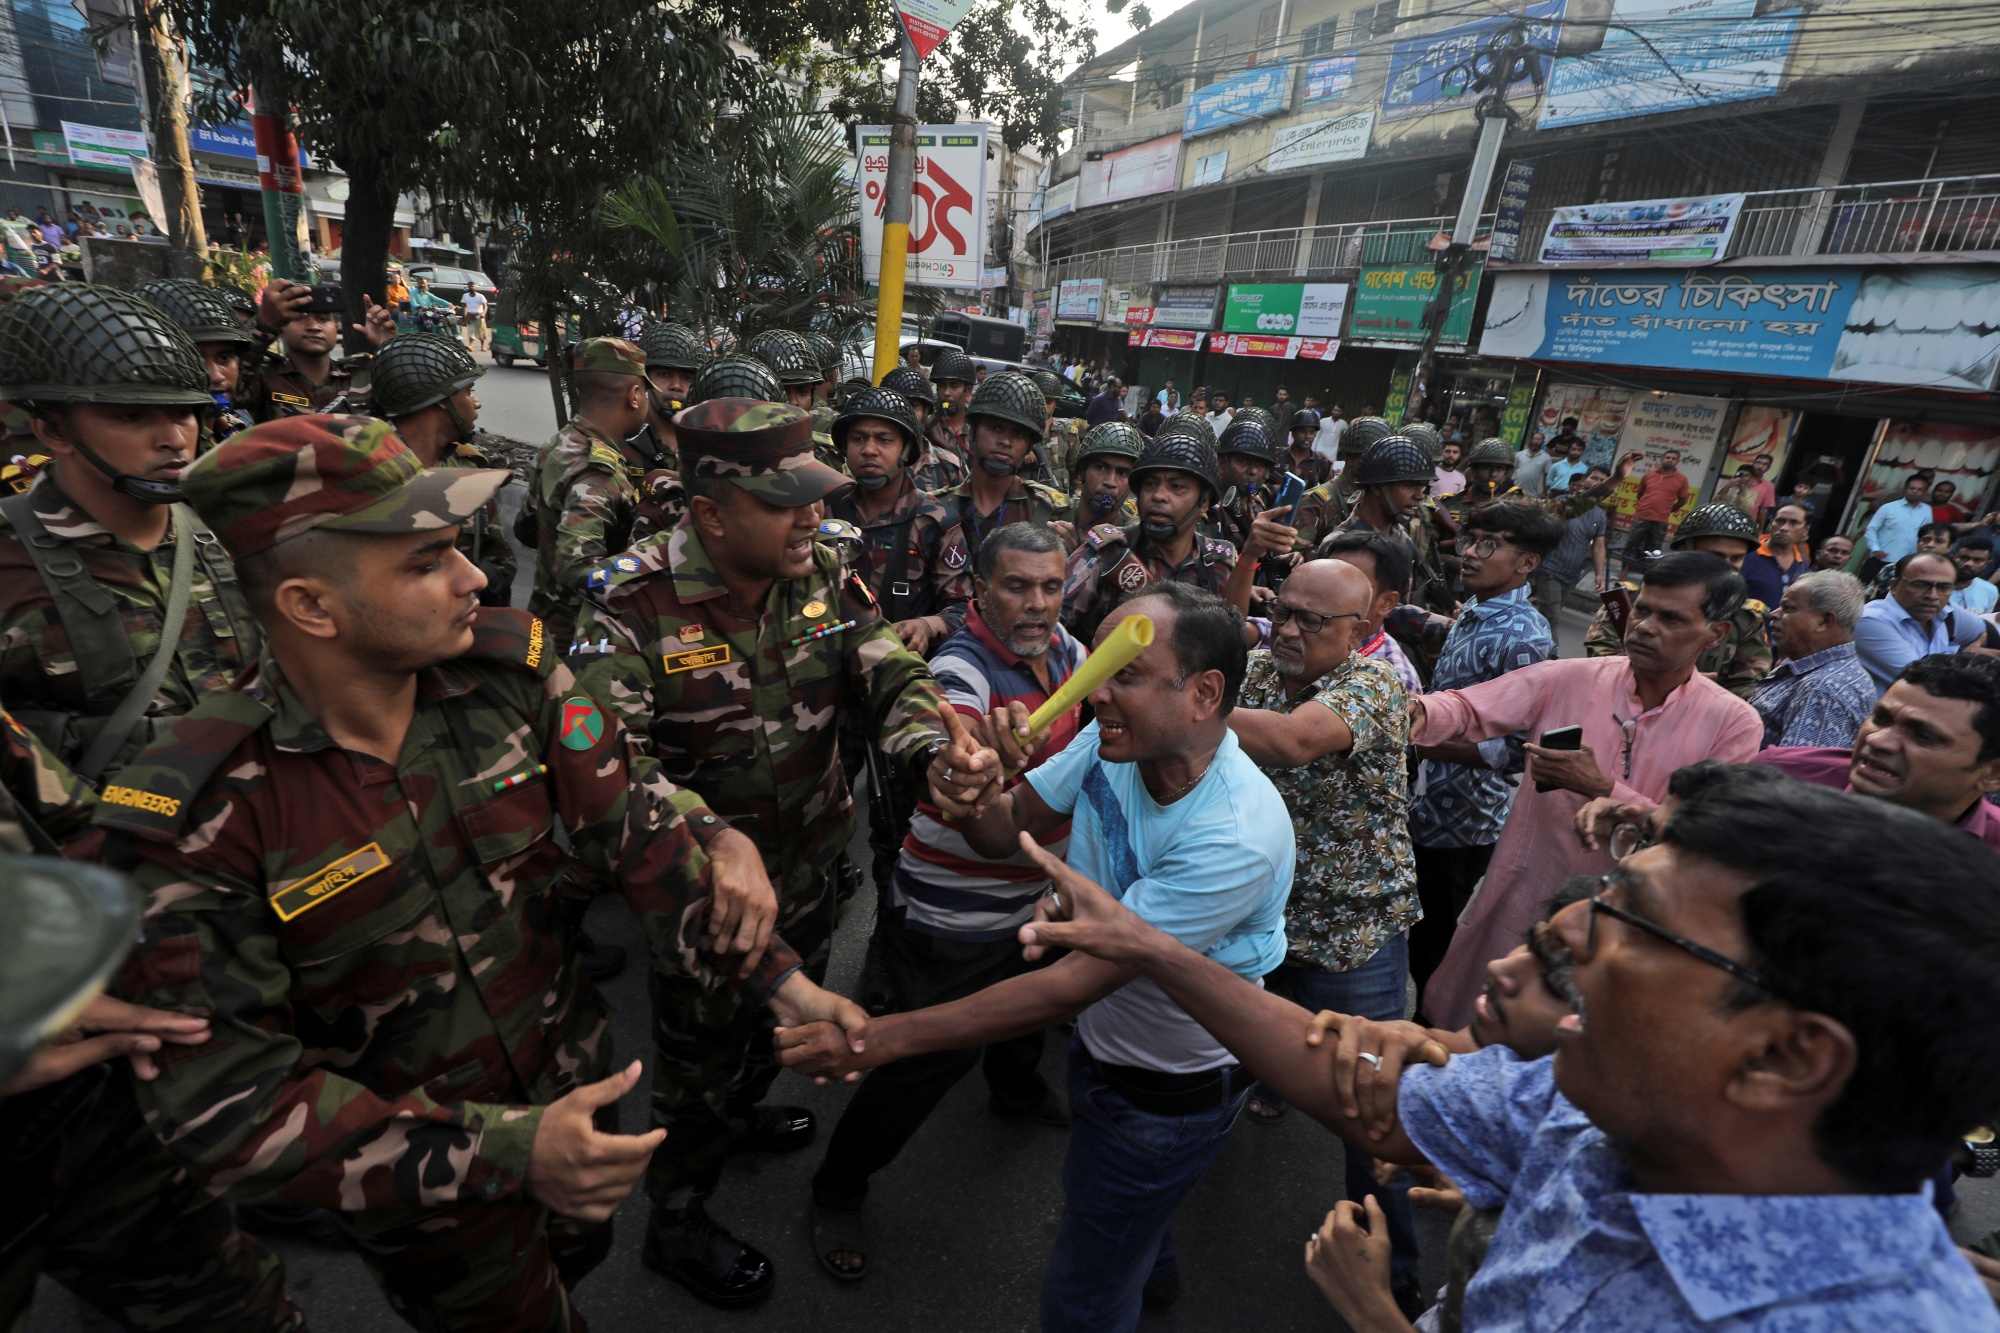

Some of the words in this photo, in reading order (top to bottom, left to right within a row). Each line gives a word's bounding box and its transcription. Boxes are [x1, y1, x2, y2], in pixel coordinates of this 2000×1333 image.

[1550, 77, 1615, 96] NURJAHAN
[1693, 61, 1703, 71] &
[1707, 47, 1783, 69] SURGICAL
[213, 131, 240, 146] Bank
[1300, 135, 1361, 153] Enterprise
[1555, 231, 1603, 239] NURJAHAN
[1605, 229, 1658, 238] SCIENTIFIC
[1670, 226, 1722, 236] SURGICAL
[1364, 269, 1409, 290] গণেশ
[1359, 293, 1381, 301] Musical
[1418, 294, 1434, 303] Shop
[1564, 275, 1671, 309] দাঁতের
[1680, 274, 1841, 314] চিকিৎসা
[1559, 311, 1621, 329] দাঁত
[1628, 313, 1754, 334] বাঁধানো
[1762, 319, 1826, 337] হয়
[1642, 401, 1673, 418] মামুন
[1675, 403, 1719, 422] ডেন্টাল
[525, 617, 544, 668] ENGINEERS
[678, 652, 717, 666] আজাদ
[100, 784, 182, 817] ENGINEERS
[303, 864, 357, 898] জাহিদ
